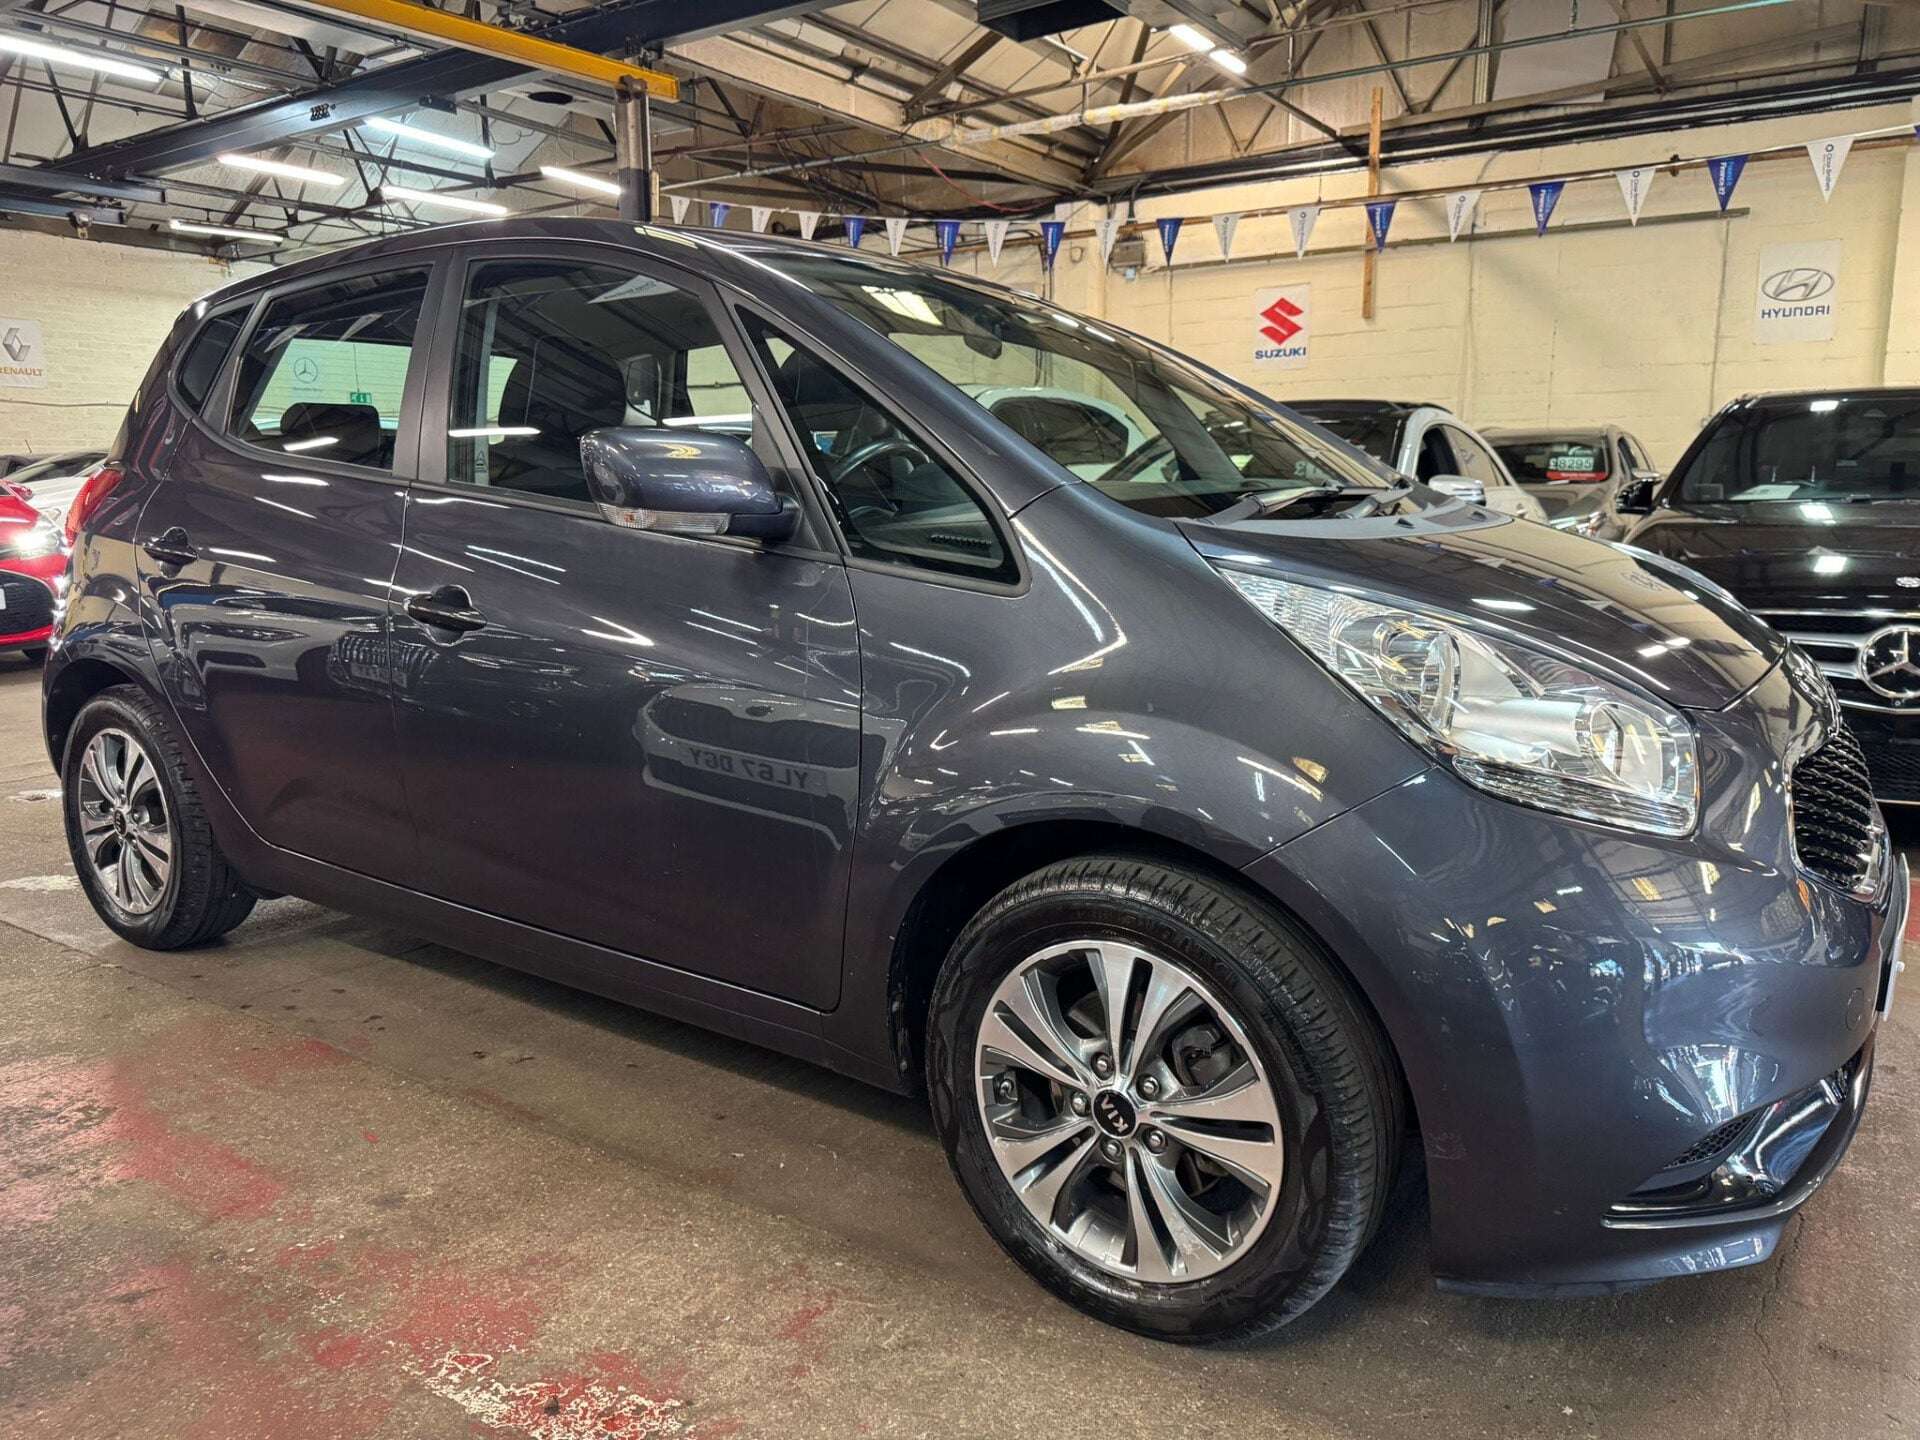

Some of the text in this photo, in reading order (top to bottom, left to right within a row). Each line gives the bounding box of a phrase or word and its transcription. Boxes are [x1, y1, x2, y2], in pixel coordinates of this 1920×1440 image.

[1761, 304, 1830, 319] HYUNDAI
[1255, 347, 1306, 359] SUZUKI
[1101, 1094, 1129, 1133] KIA
